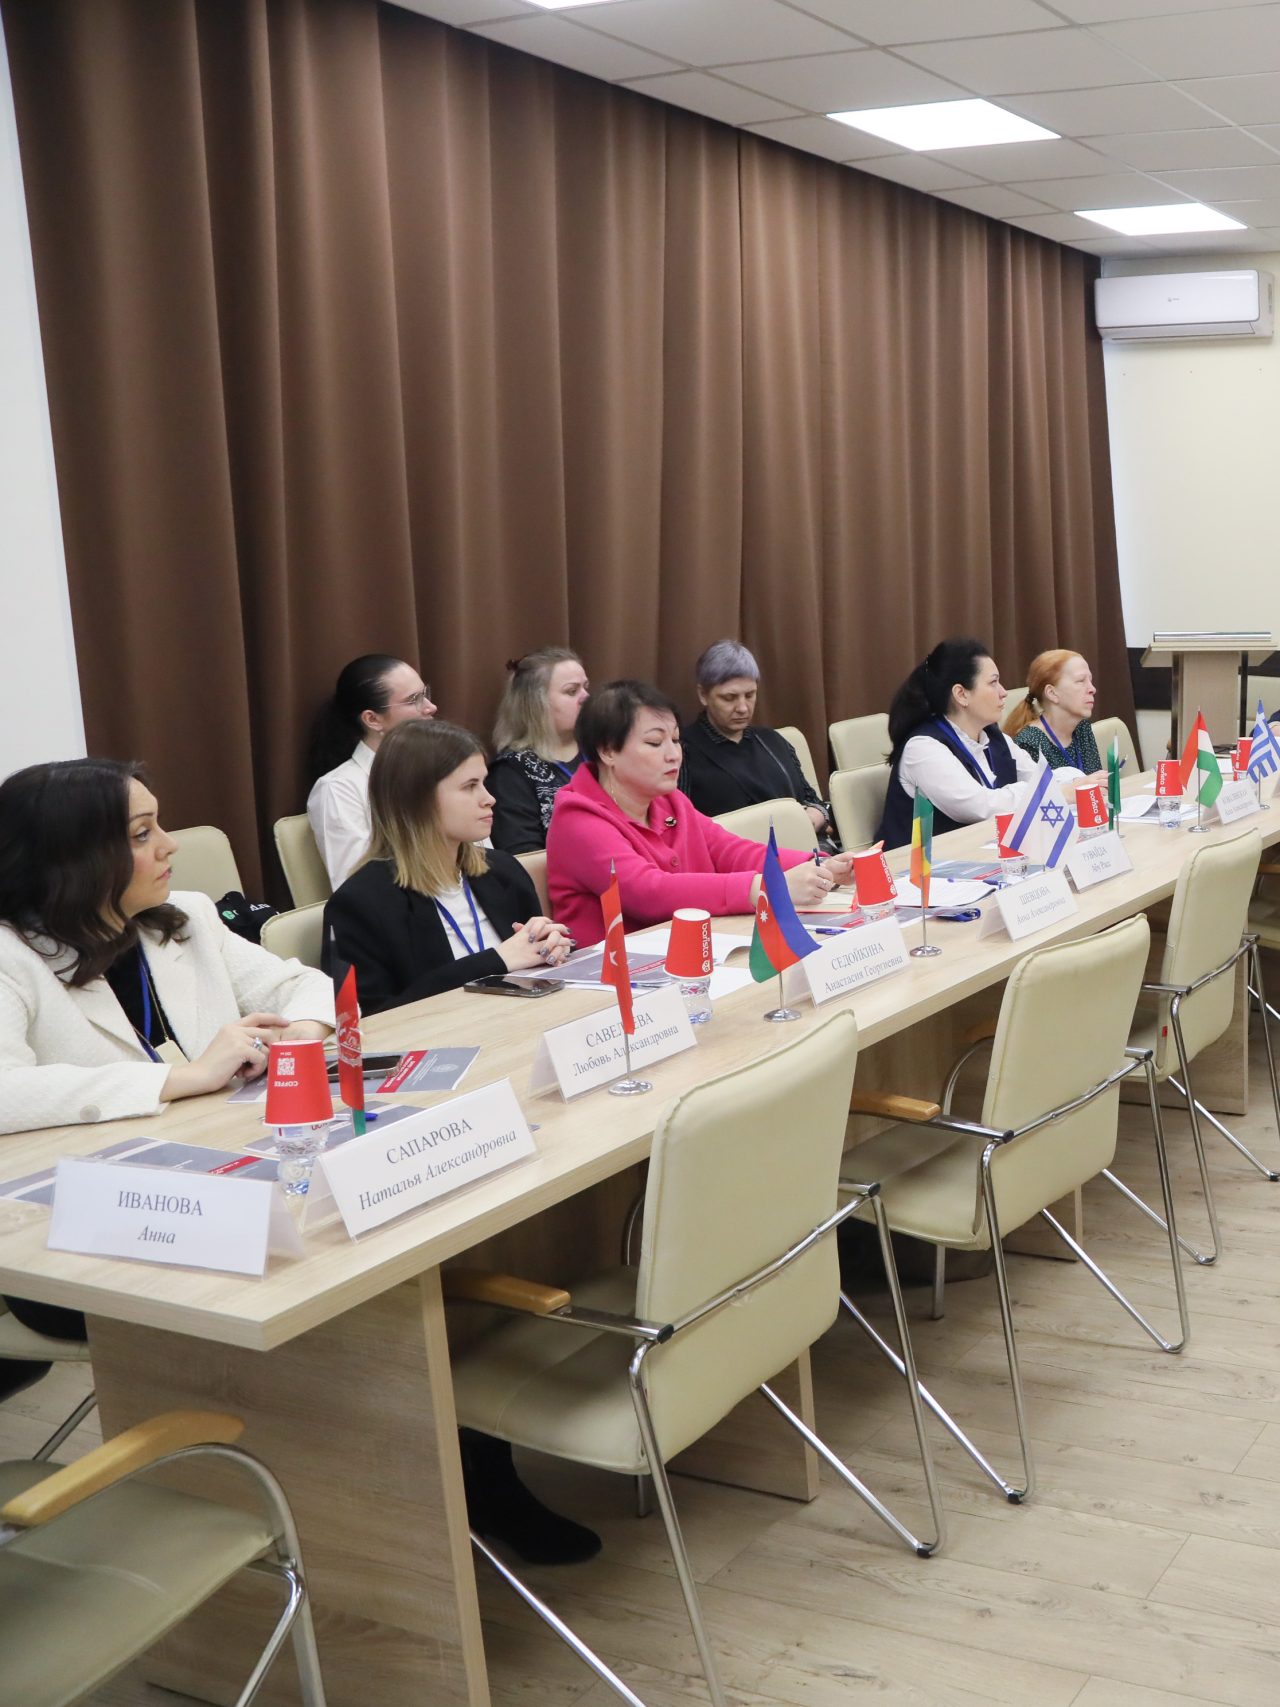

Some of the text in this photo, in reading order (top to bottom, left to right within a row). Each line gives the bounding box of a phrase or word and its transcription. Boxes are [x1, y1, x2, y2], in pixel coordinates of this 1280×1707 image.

[824, 955, 904, 993] Анастасия Георгиевна
[831, 942, 885, 971] СЕДОЙКИНА
[585, 1011, 654, 1048] САВЕЛВА
[572, 1025, 679, 1077] Любовь Алксандровна
[386, 1118, 473, 1165] САПАРОВА
[358, 1129, 518, 1210] Наталья Александровна
[117, 1190, 204, 1217] ИВАНОВА
[137, 1225, 176, 1244] Анна
